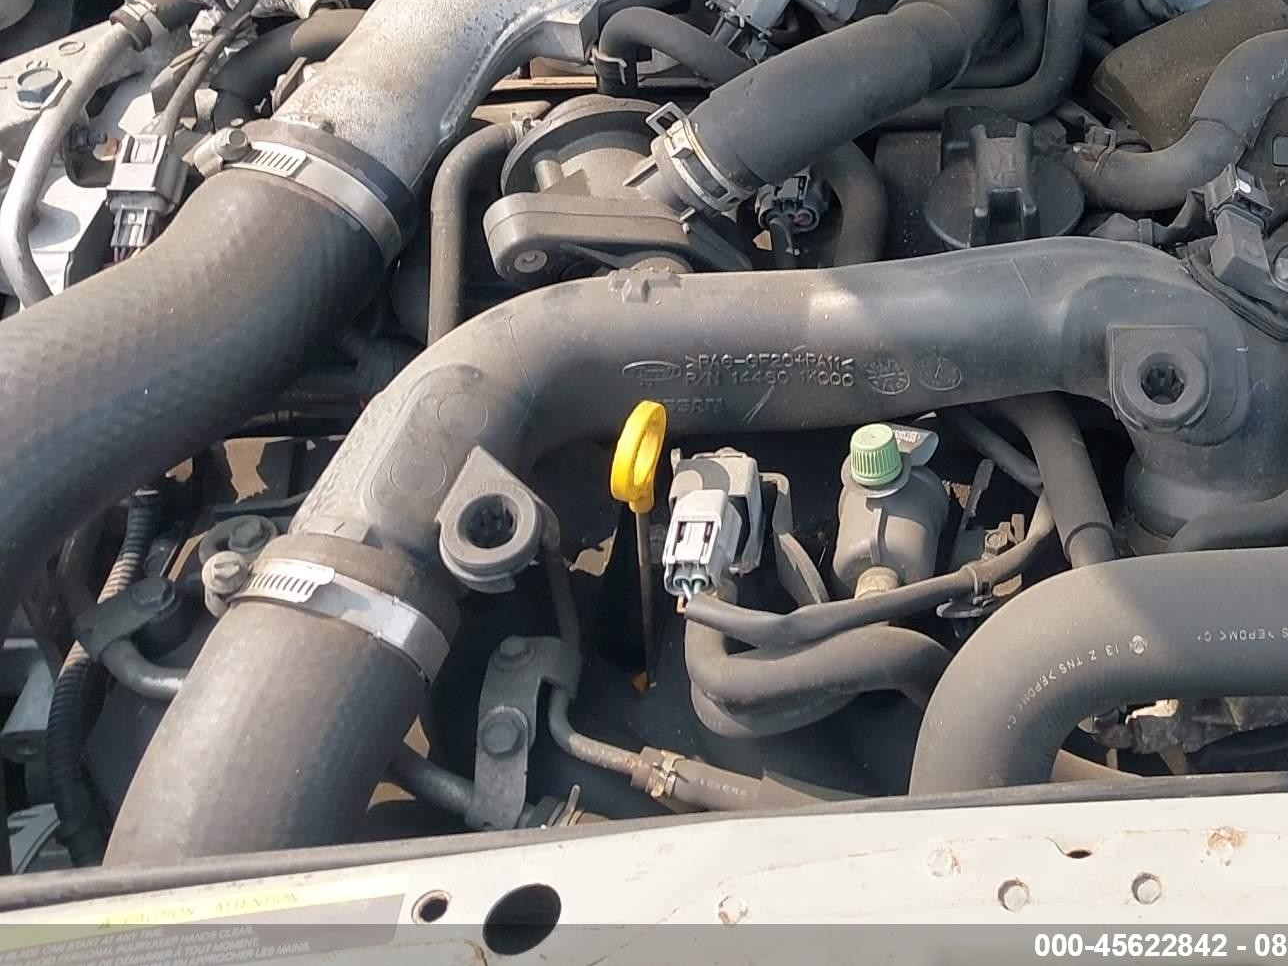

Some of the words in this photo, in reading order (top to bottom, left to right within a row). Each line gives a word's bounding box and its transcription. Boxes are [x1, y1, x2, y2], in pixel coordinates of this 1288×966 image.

[1089, 650, 1097, 661] Z
[1105, 644, 1119, 657] 13
[1059, 656, 1084, 674] TNS
